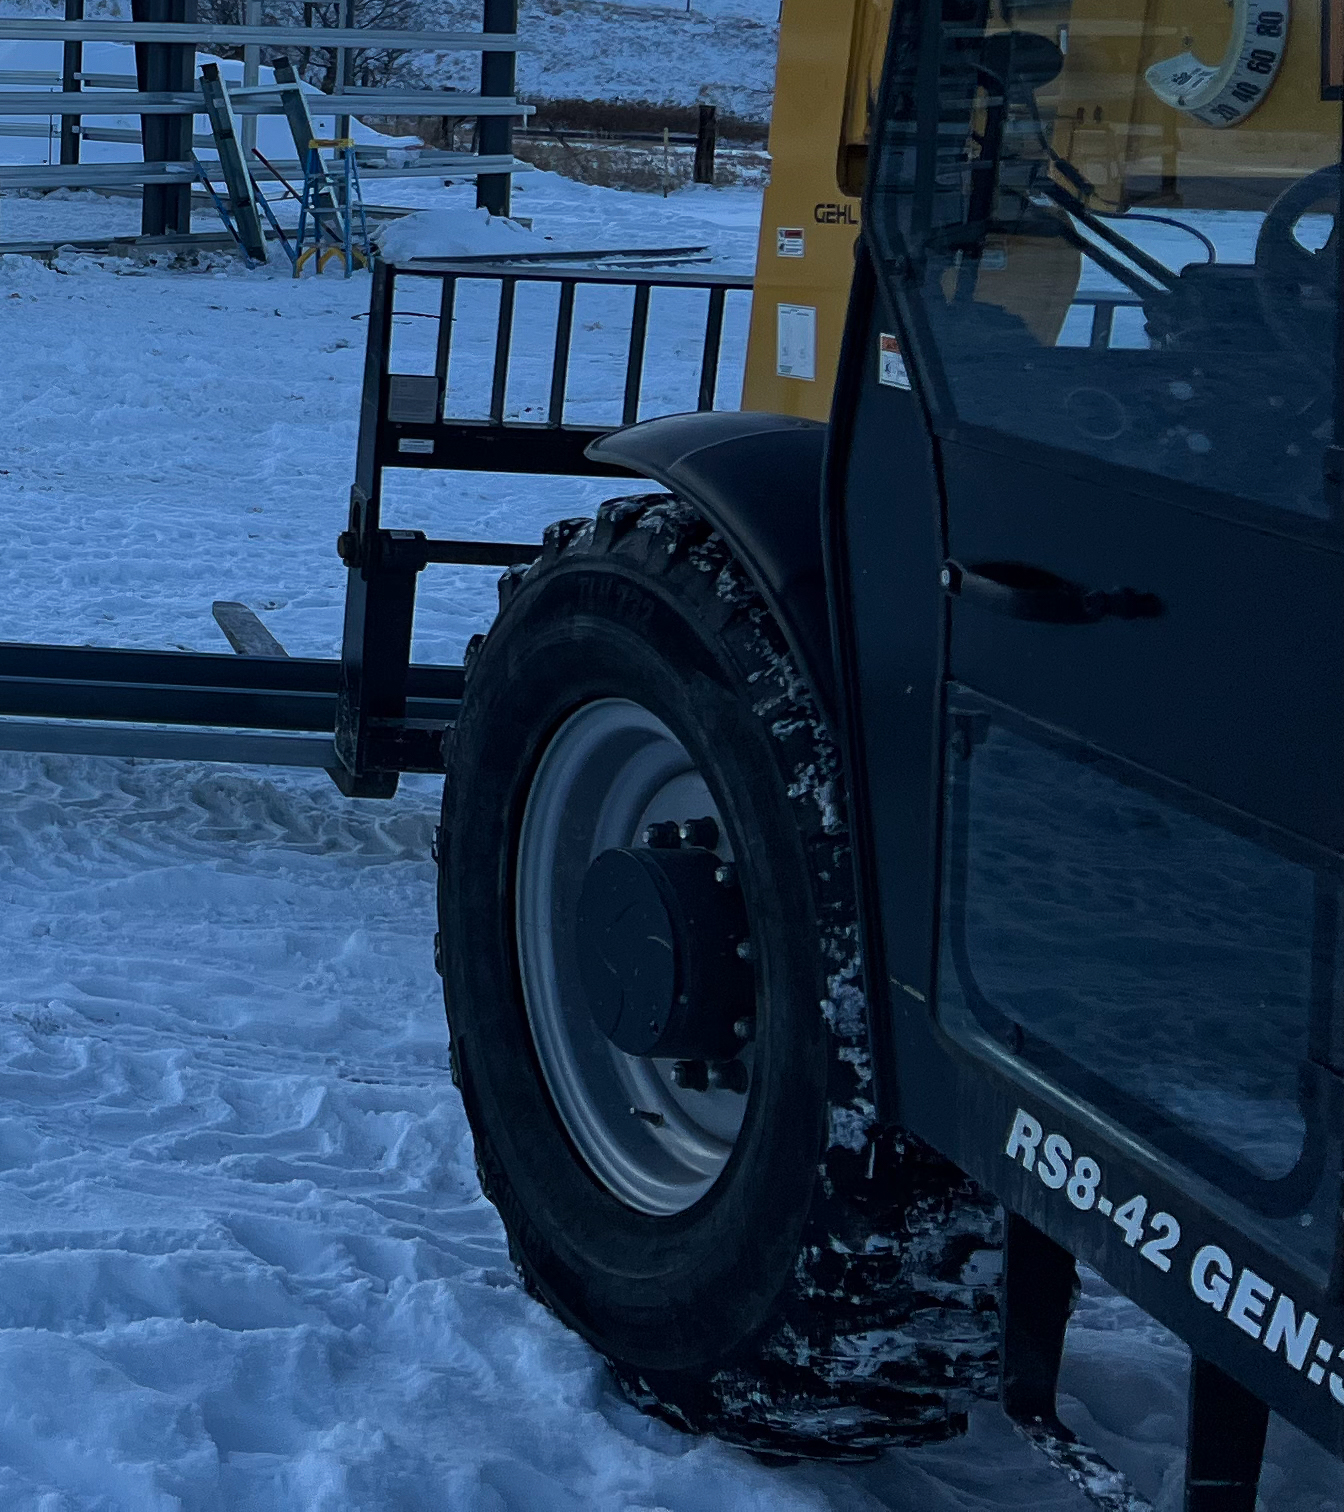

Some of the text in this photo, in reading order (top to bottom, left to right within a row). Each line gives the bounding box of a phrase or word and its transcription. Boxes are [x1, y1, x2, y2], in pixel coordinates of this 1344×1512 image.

[1256, 11, 1284, 37] 80
[1247, 49, 1276, 74] 60
[1232, 81, 1260, 103] 40
[814, 203, 858, 225] GEHL
[1005, 1107, 1181, 1273] RS8-42
